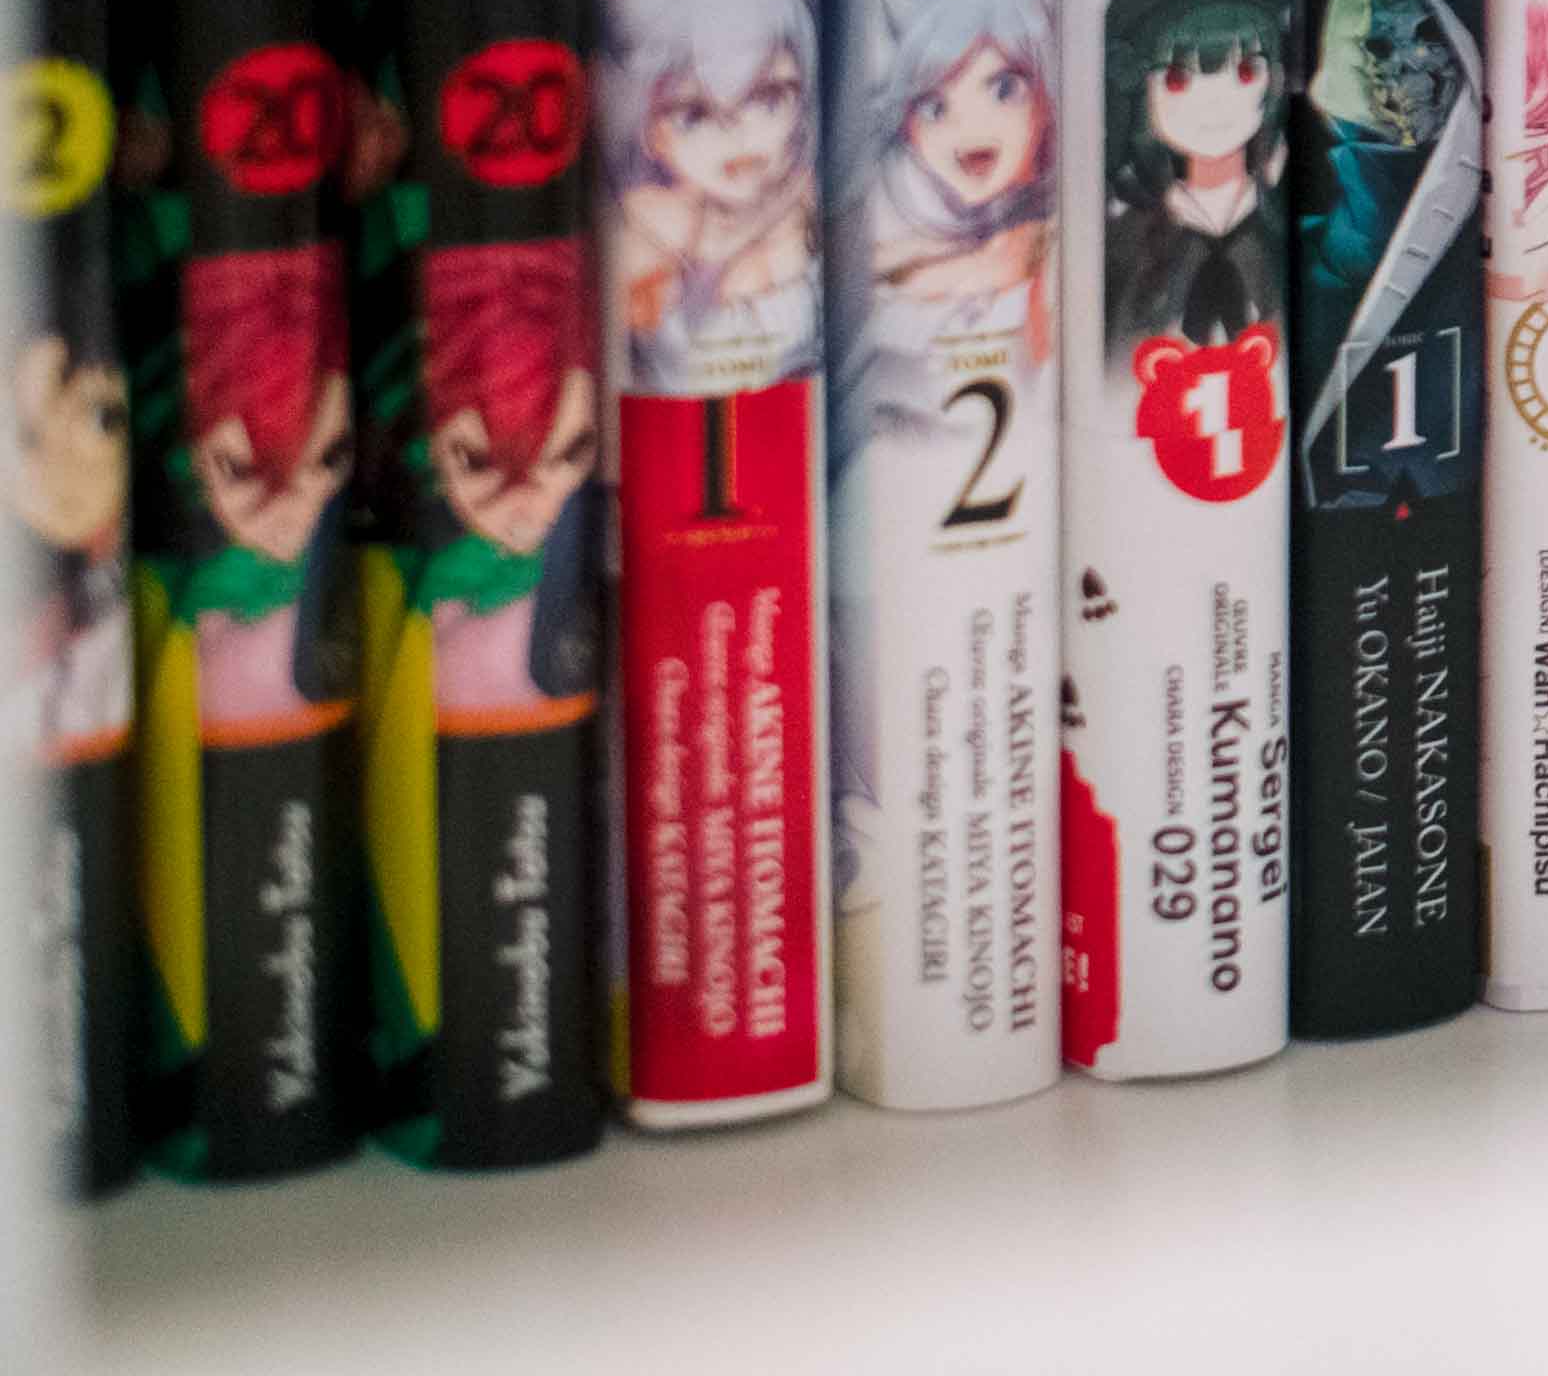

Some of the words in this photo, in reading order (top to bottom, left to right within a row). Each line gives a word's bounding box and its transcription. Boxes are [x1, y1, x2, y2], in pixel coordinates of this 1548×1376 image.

[938, 377, 1028, 529] 2
[1185, 372, 1242, 480] 1
[1383, 351, 1428, 452] 1
[1353, 575, 1390, 624] Yu
[1404, 565, 1450, 661] Haiji
[1008, 684, 1035, 810] AKINE
[1165, 662, 1185, 732] CHARA
[1355, 629, 1390, 782] OKANO
[1165, 735, 1186, 817] DESIGN
[1250, 736, 1289, 904] Sergei
[1415, 668, 1450, 929] NAKASONE
[965, 811, 993, 896] MIYA
[1151, 824, 1198, 923] 029
[1208, 697, 1251, 994] Kumanano
[1347, 819, 1389, 938] JAIAN
[918, 830, 950, 986] KATAGIRI
[961, 903, 995, 1033] KINOJO
[1008, 819, 1037, 1033] ITOMACHI
